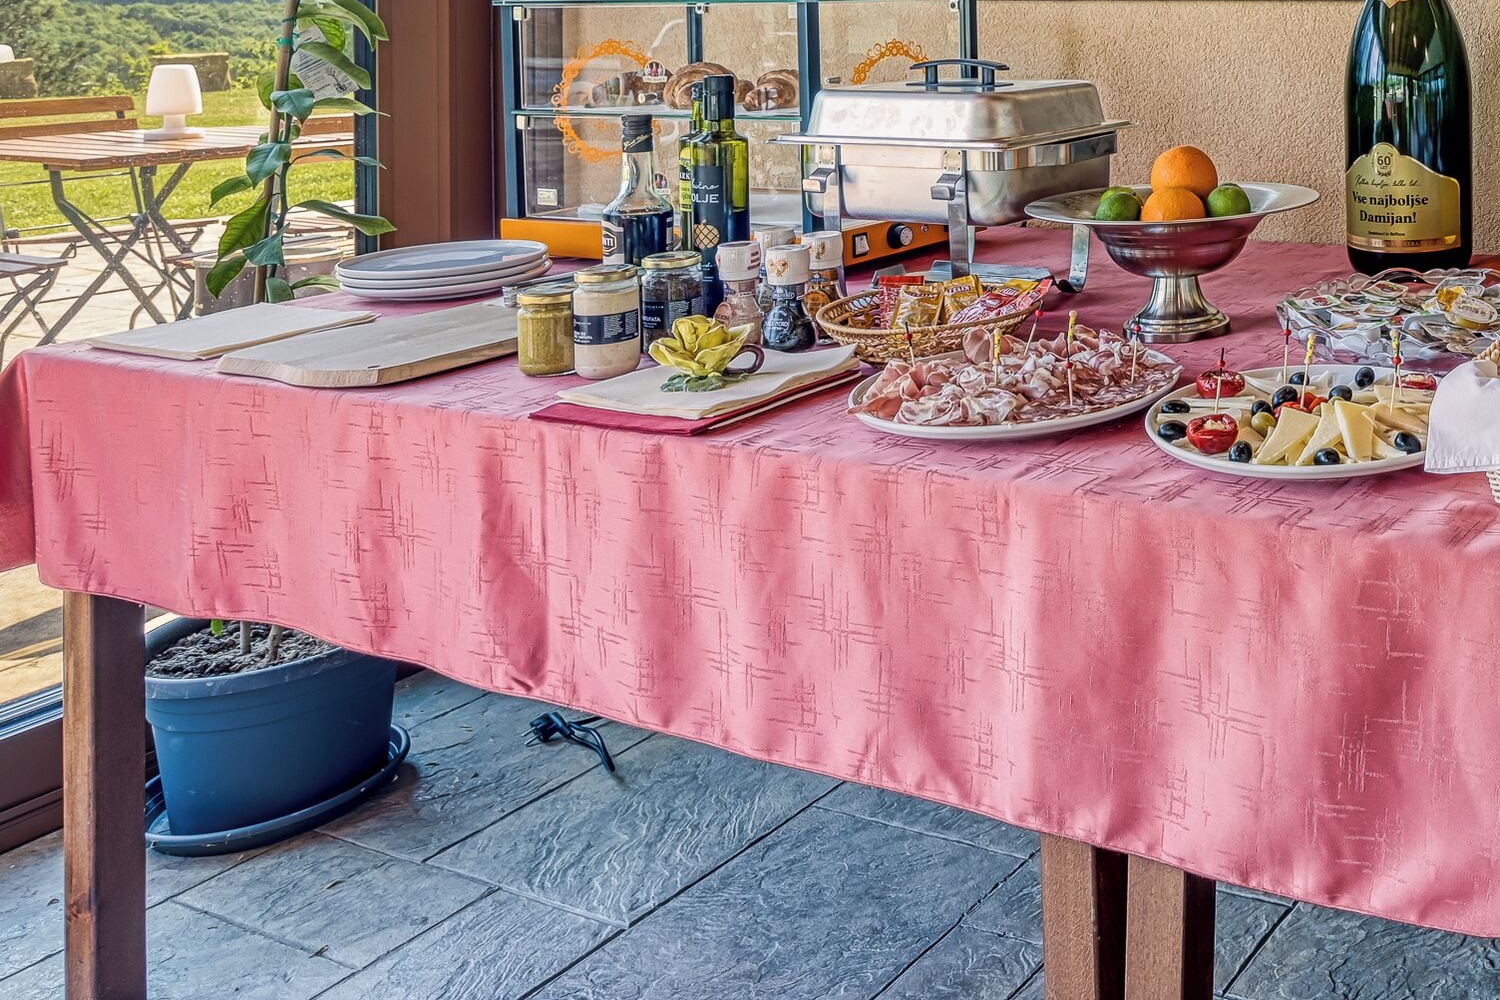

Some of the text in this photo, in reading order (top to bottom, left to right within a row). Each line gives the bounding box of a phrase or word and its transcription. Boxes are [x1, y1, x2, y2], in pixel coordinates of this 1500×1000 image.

[1377, 156, 1391, 166] 60
[691, 193, 720, 204] OLJE
[1352, 191, 1429, 209] Vse najboljše
[1360, 210, 1417, 226] Damijan!
